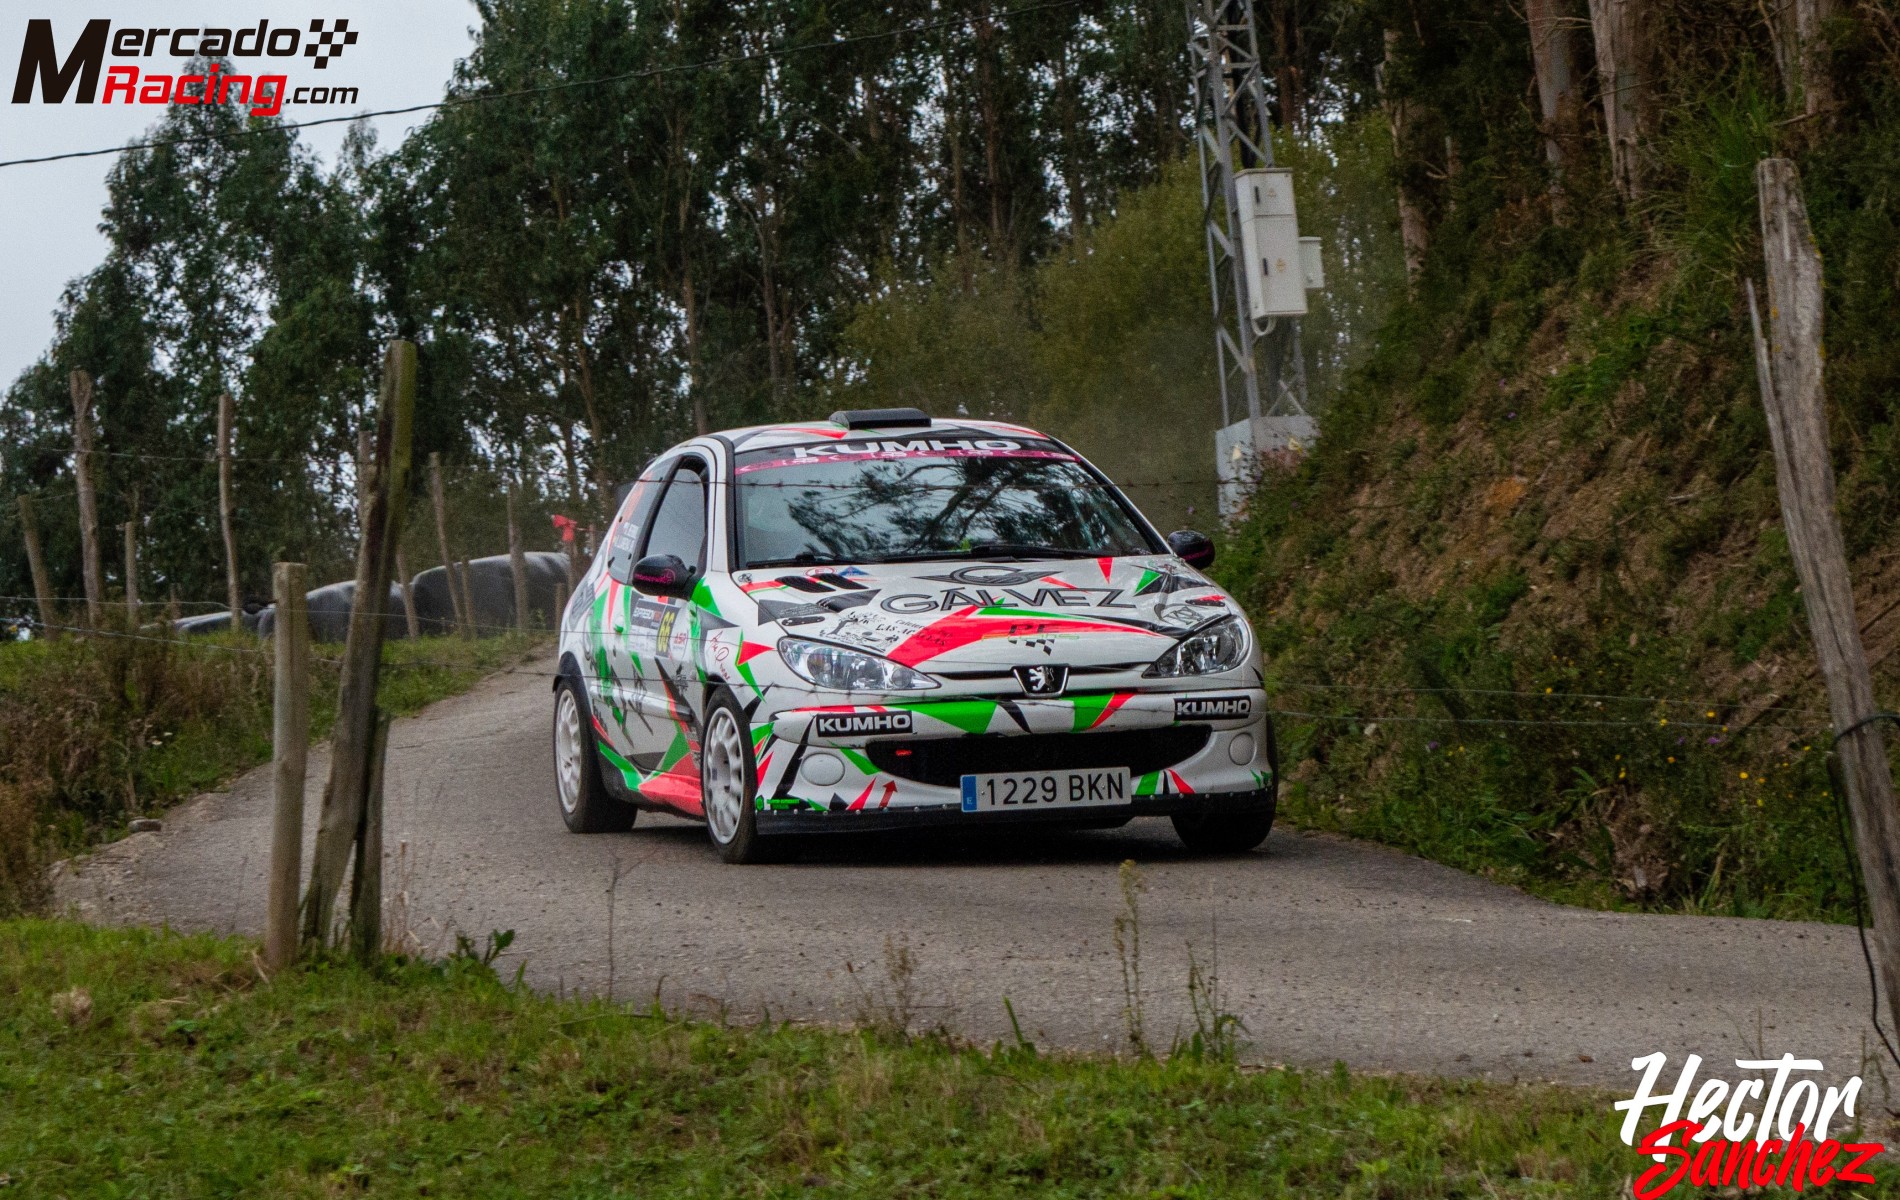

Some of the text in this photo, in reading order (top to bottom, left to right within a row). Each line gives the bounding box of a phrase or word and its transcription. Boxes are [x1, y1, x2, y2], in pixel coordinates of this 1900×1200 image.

[794, 440, 1022, 459] KUMHO
[1176, 699, 1251, 716] KUMHO
[819, 714, 912, 732] KUMHO
[986, 776, 1058, 806] 1229
[1068, 772, 1124, 802] BKN
